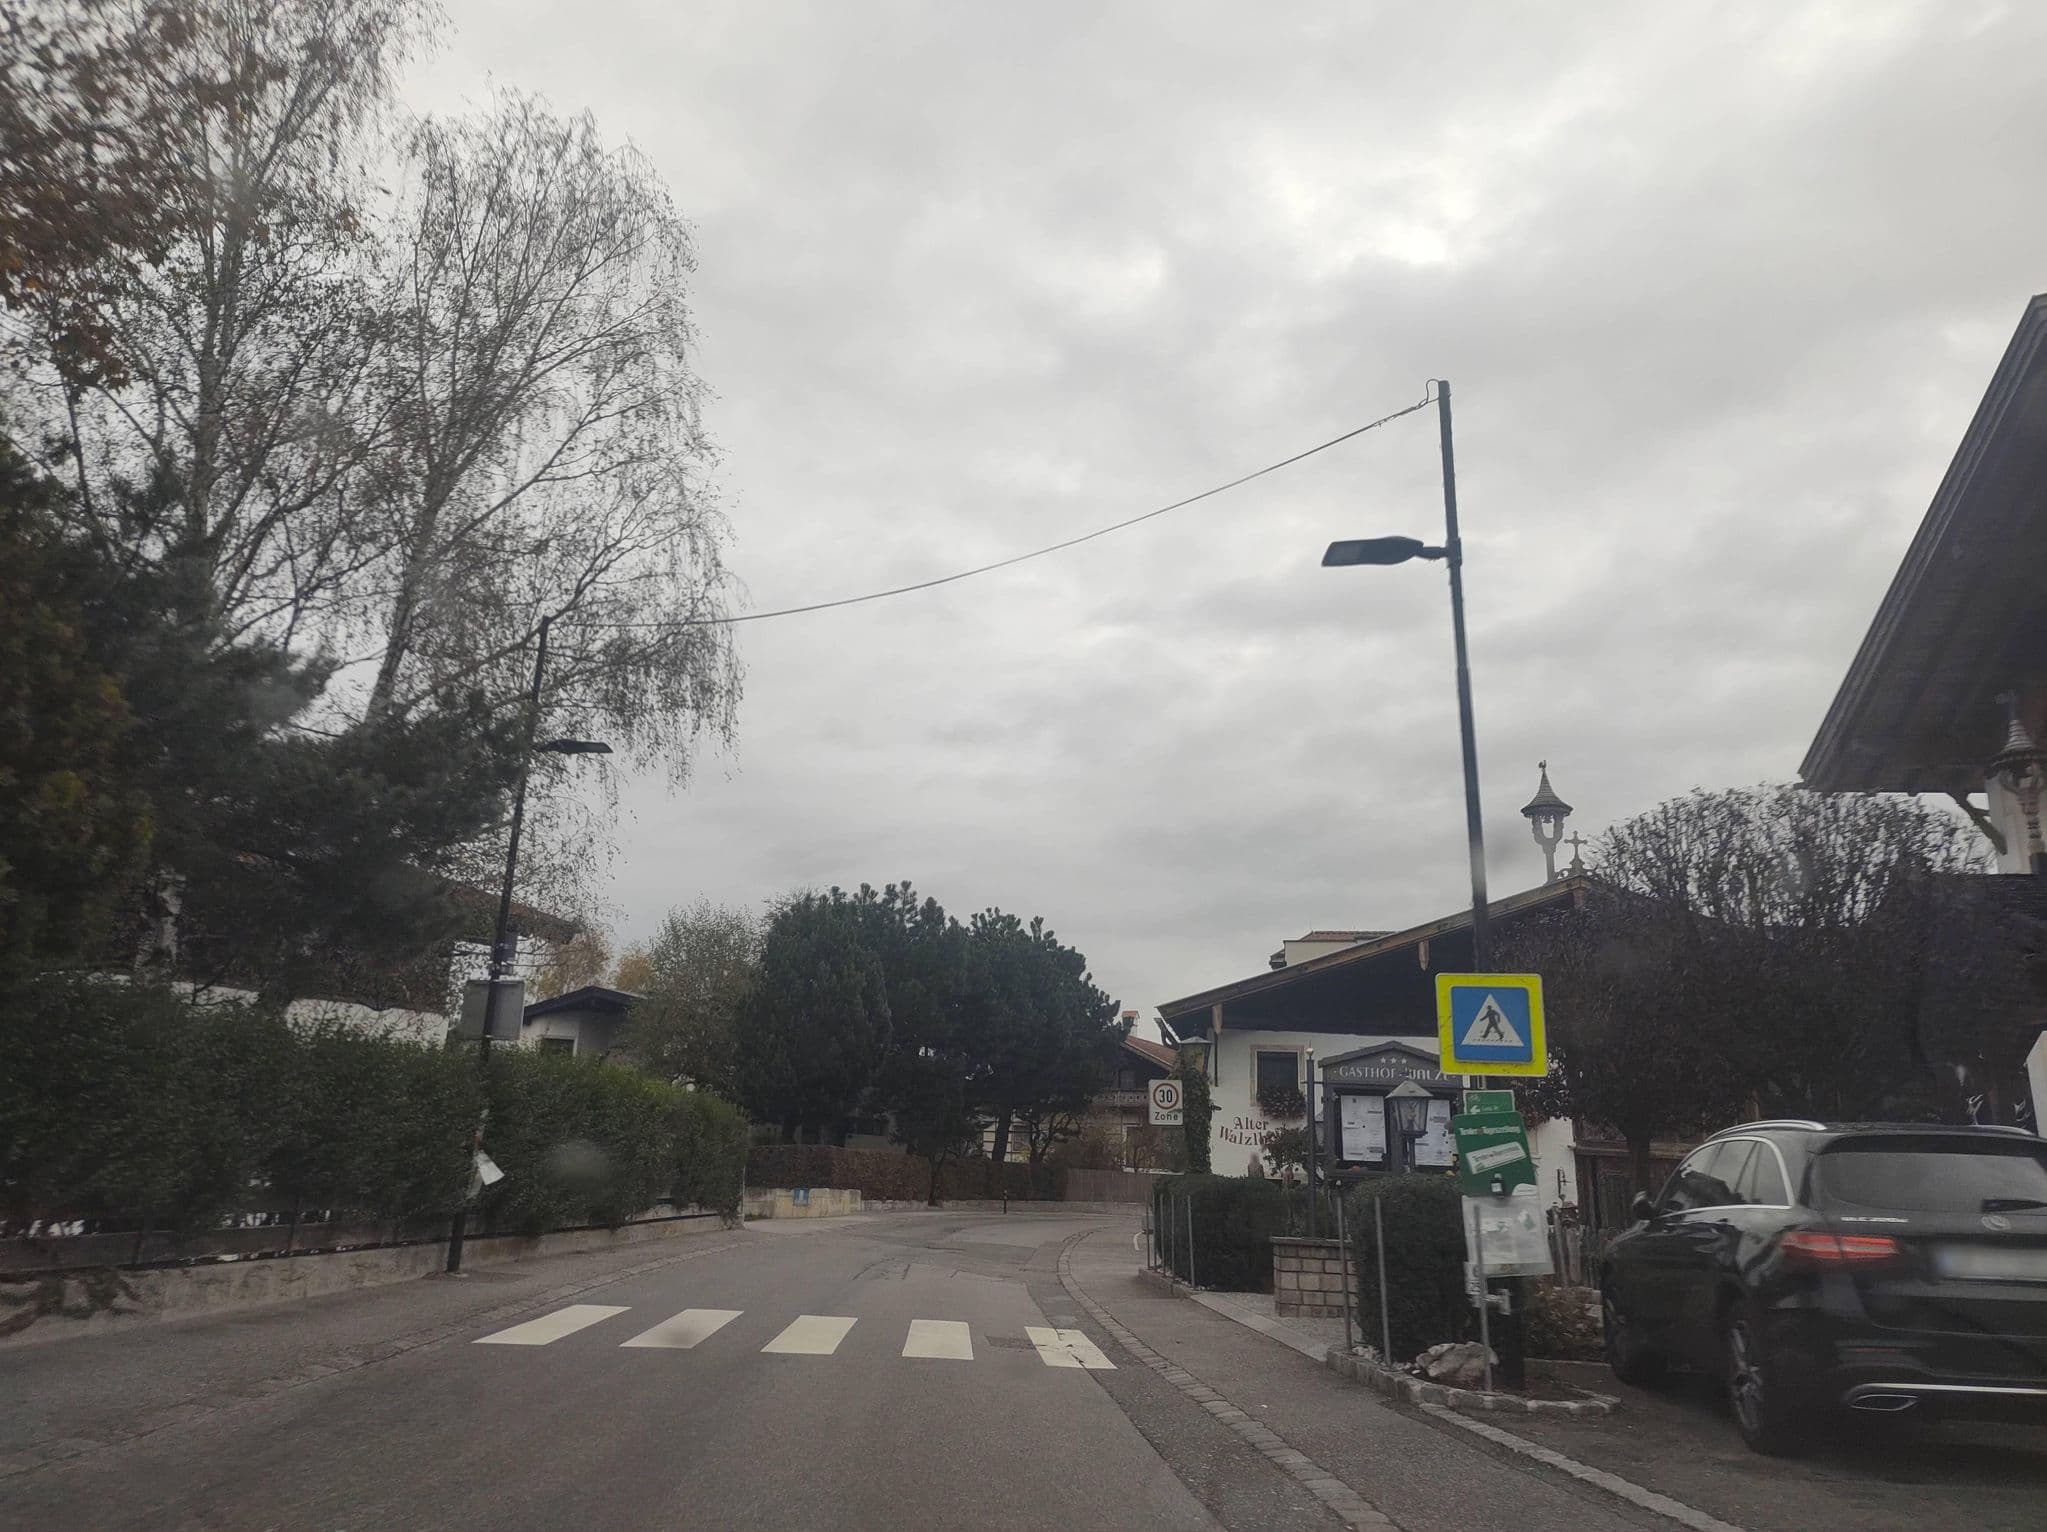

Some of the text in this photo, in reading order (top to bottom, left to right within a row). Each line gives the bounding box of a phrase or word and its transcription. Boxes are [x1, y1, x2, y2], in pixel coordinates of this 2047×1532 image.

[1339, 1066, 1397, 1079] GASTHOF
[1158, 1089, 1173, 1104] 30
[1154, 1111, 1179, 1121] Zone
[1233, 1116, 1269, 1130] Alter
